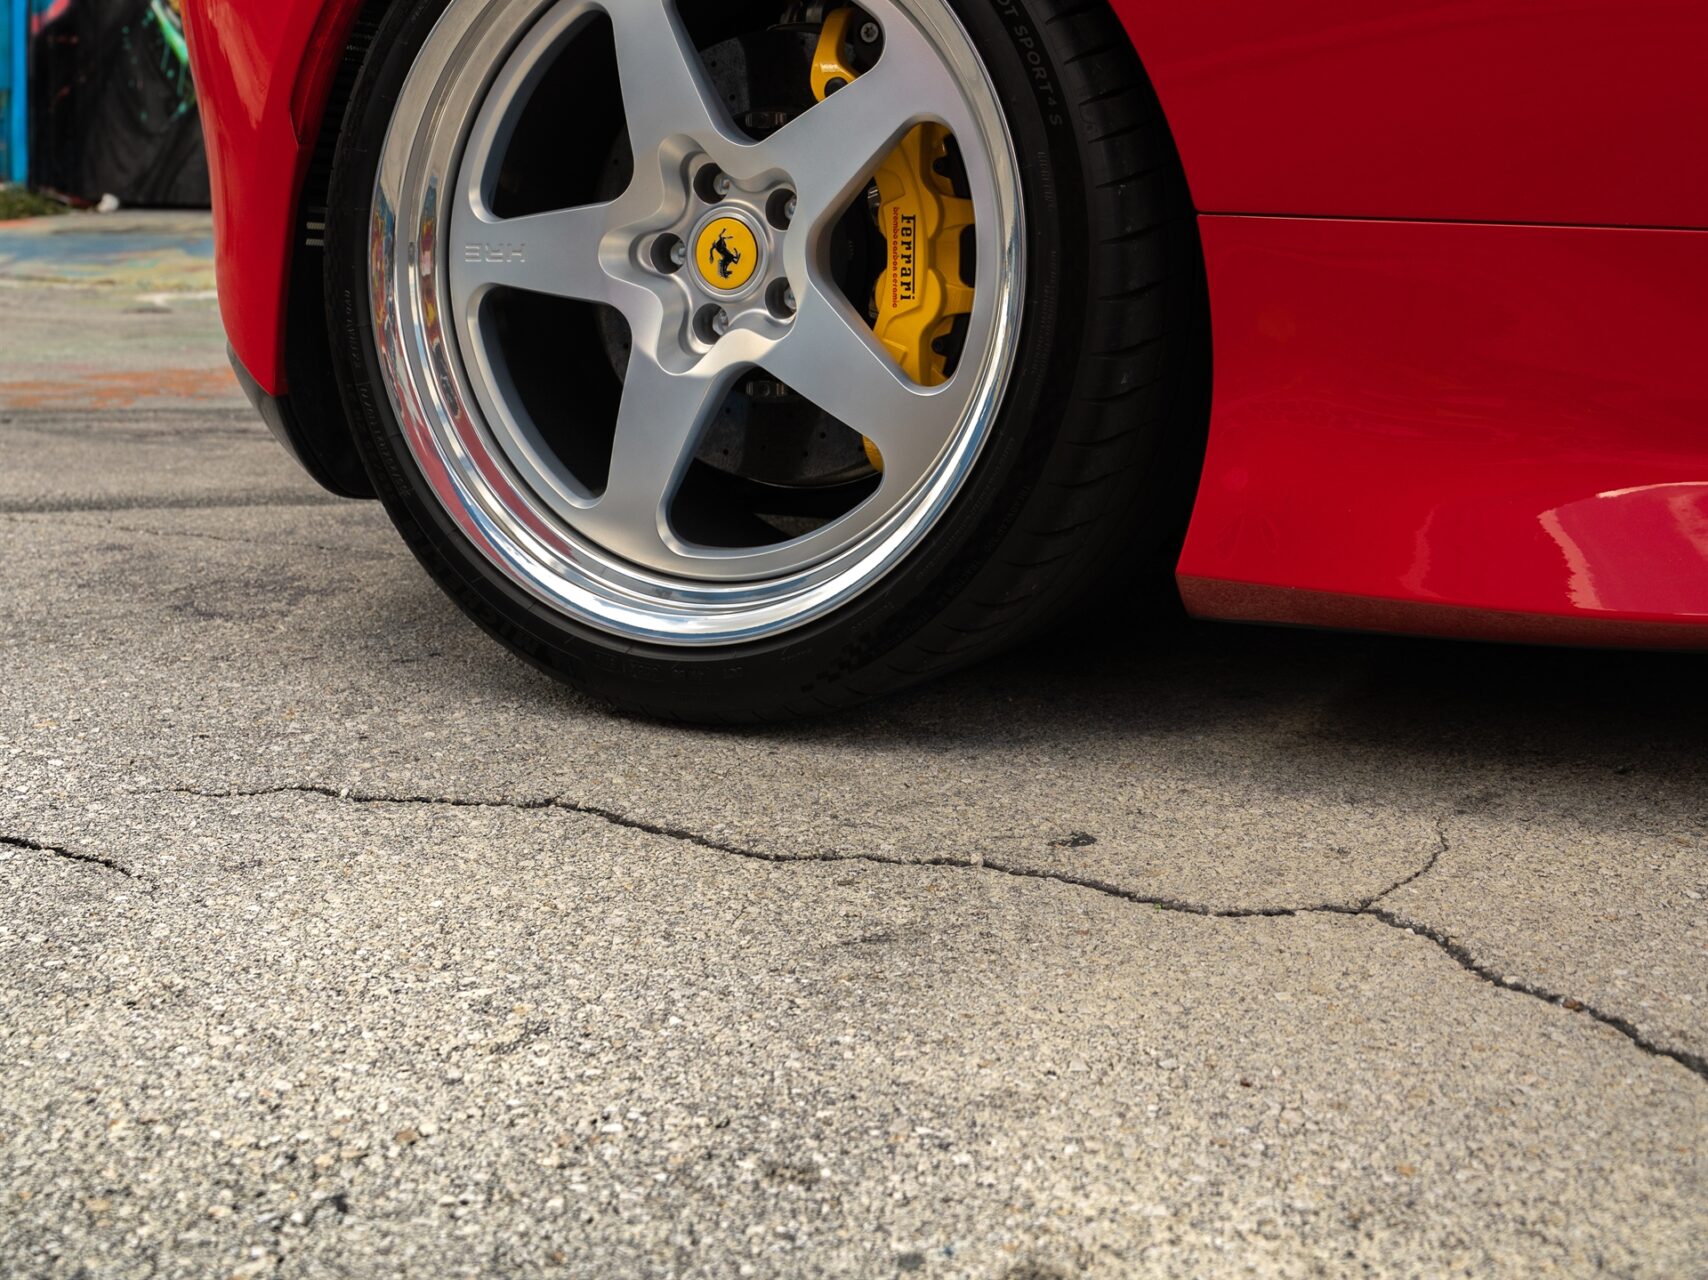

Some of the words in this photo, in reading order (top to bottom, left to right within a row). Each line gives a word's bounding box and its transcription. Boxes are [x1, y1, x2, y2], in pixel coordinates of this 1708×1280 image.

[892, 206, 901, 239] brembo
[892, 240, 900, 271] carbon
[900, 213, 917, 301] Ferrari
[892, 272, 900, 308] ceramic
